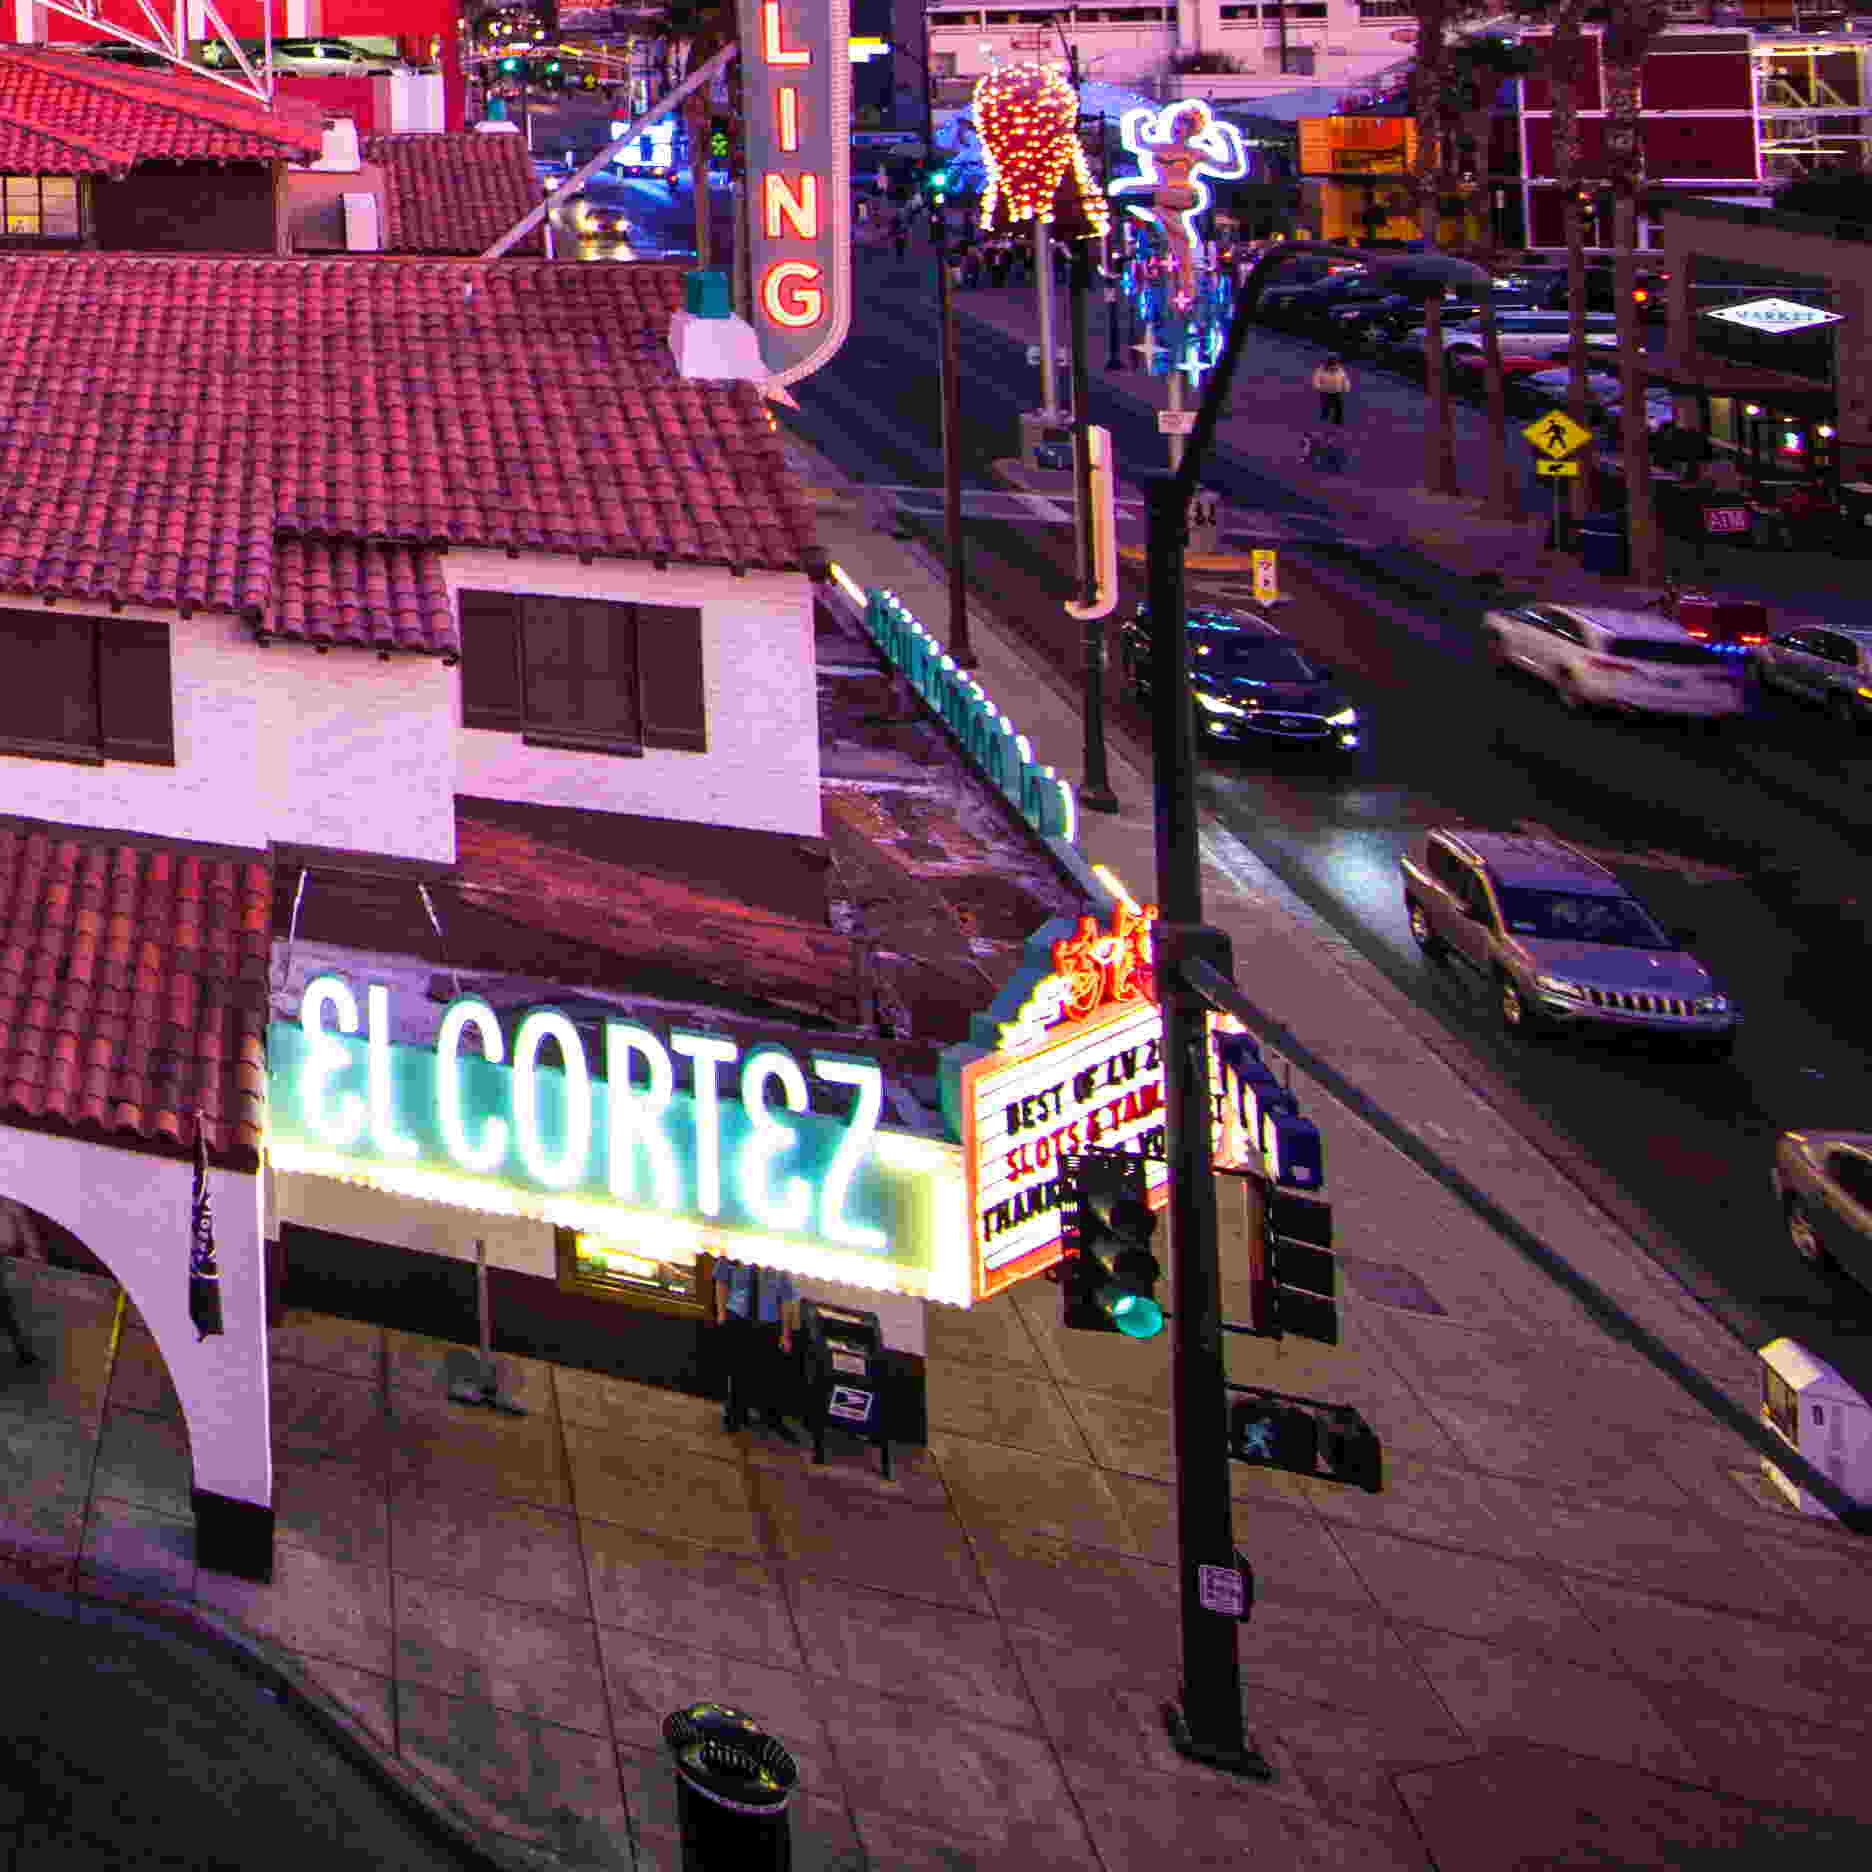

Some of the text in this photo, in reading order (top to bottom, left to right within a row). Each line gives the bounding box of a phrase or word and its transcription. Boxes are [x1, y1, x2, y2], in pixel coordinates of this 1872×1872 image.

[1735, 309, 1817, 322] MARKET
[1712, 510, 1746, 529] ATM
[299, 973, 892, 1252] EL CORTEZ
[1006, 1081, 1065, 1136] BEST
[1006, 1121, 1083, 1182] SLOTS
